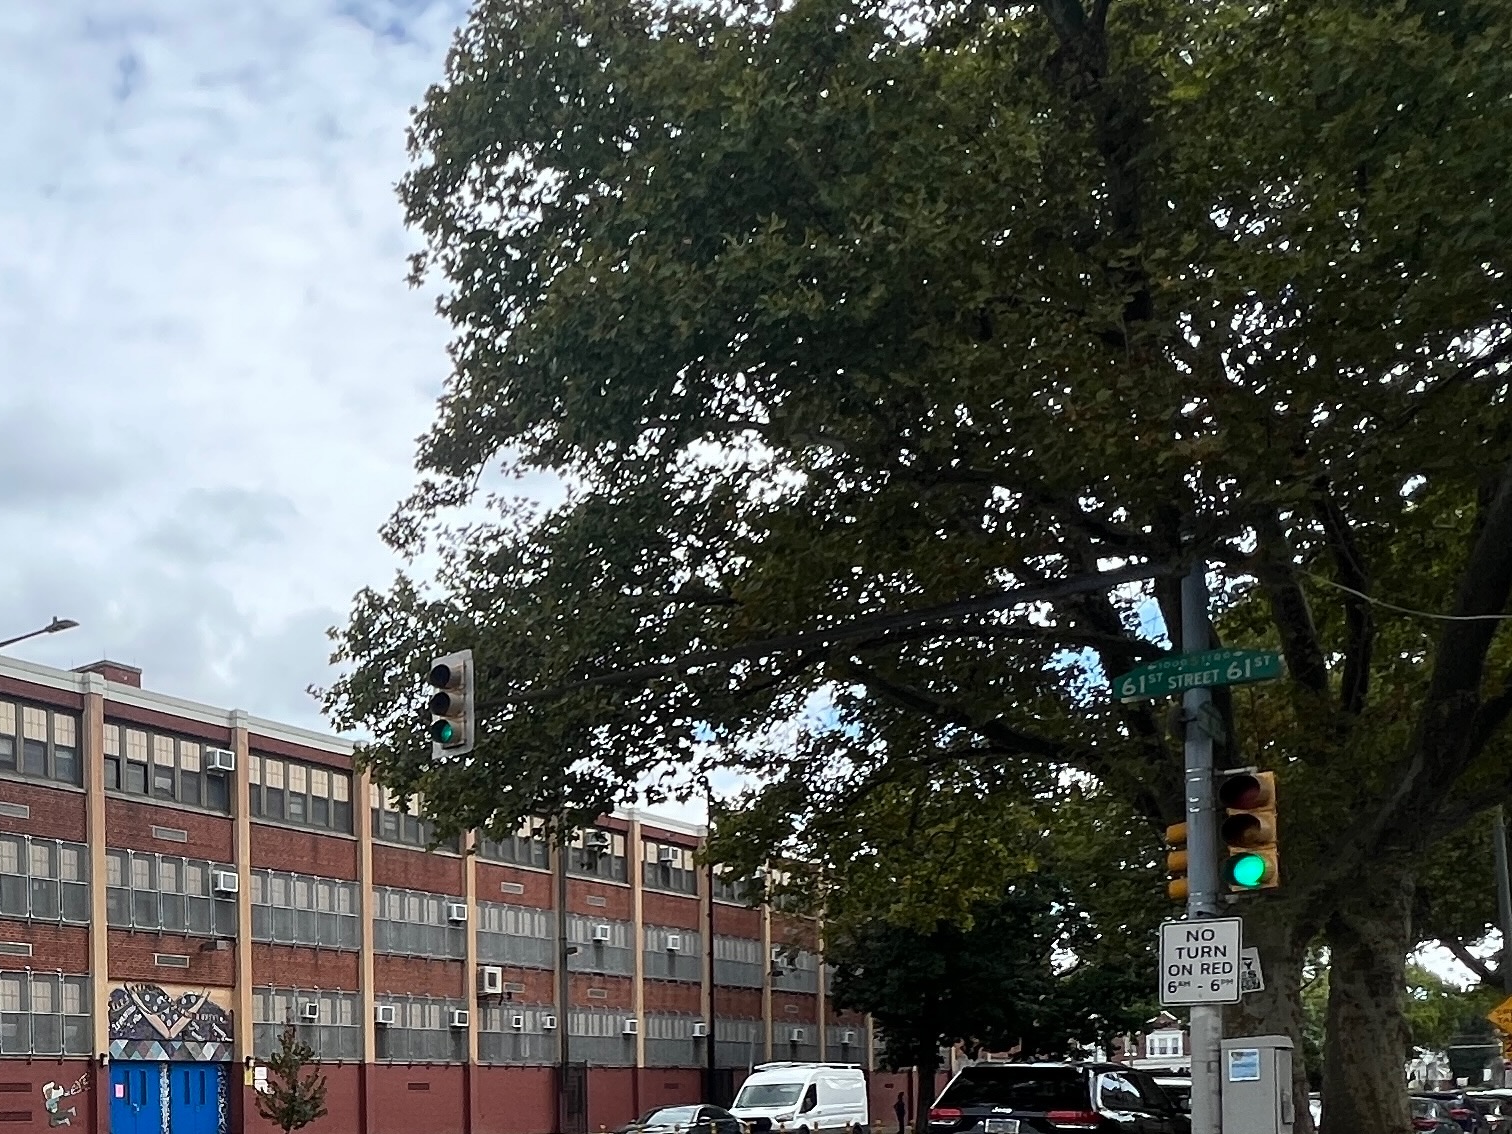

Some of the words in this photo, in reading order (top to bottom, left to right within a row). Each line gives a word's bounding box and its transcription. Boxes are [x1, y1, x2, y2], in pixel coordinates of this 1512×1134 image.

[1121, 672, 1163, 696] 61ST
[1168, 669, 1220, 690] STREET
[1226, 655, 1271, 680] 61ST
[1186, 929, 1215, 942] NO
[1175, 945, 1227, 960] TURN
[1168, 964, 1193, 977] ON
[1200, 961, 1233, 975] RED
